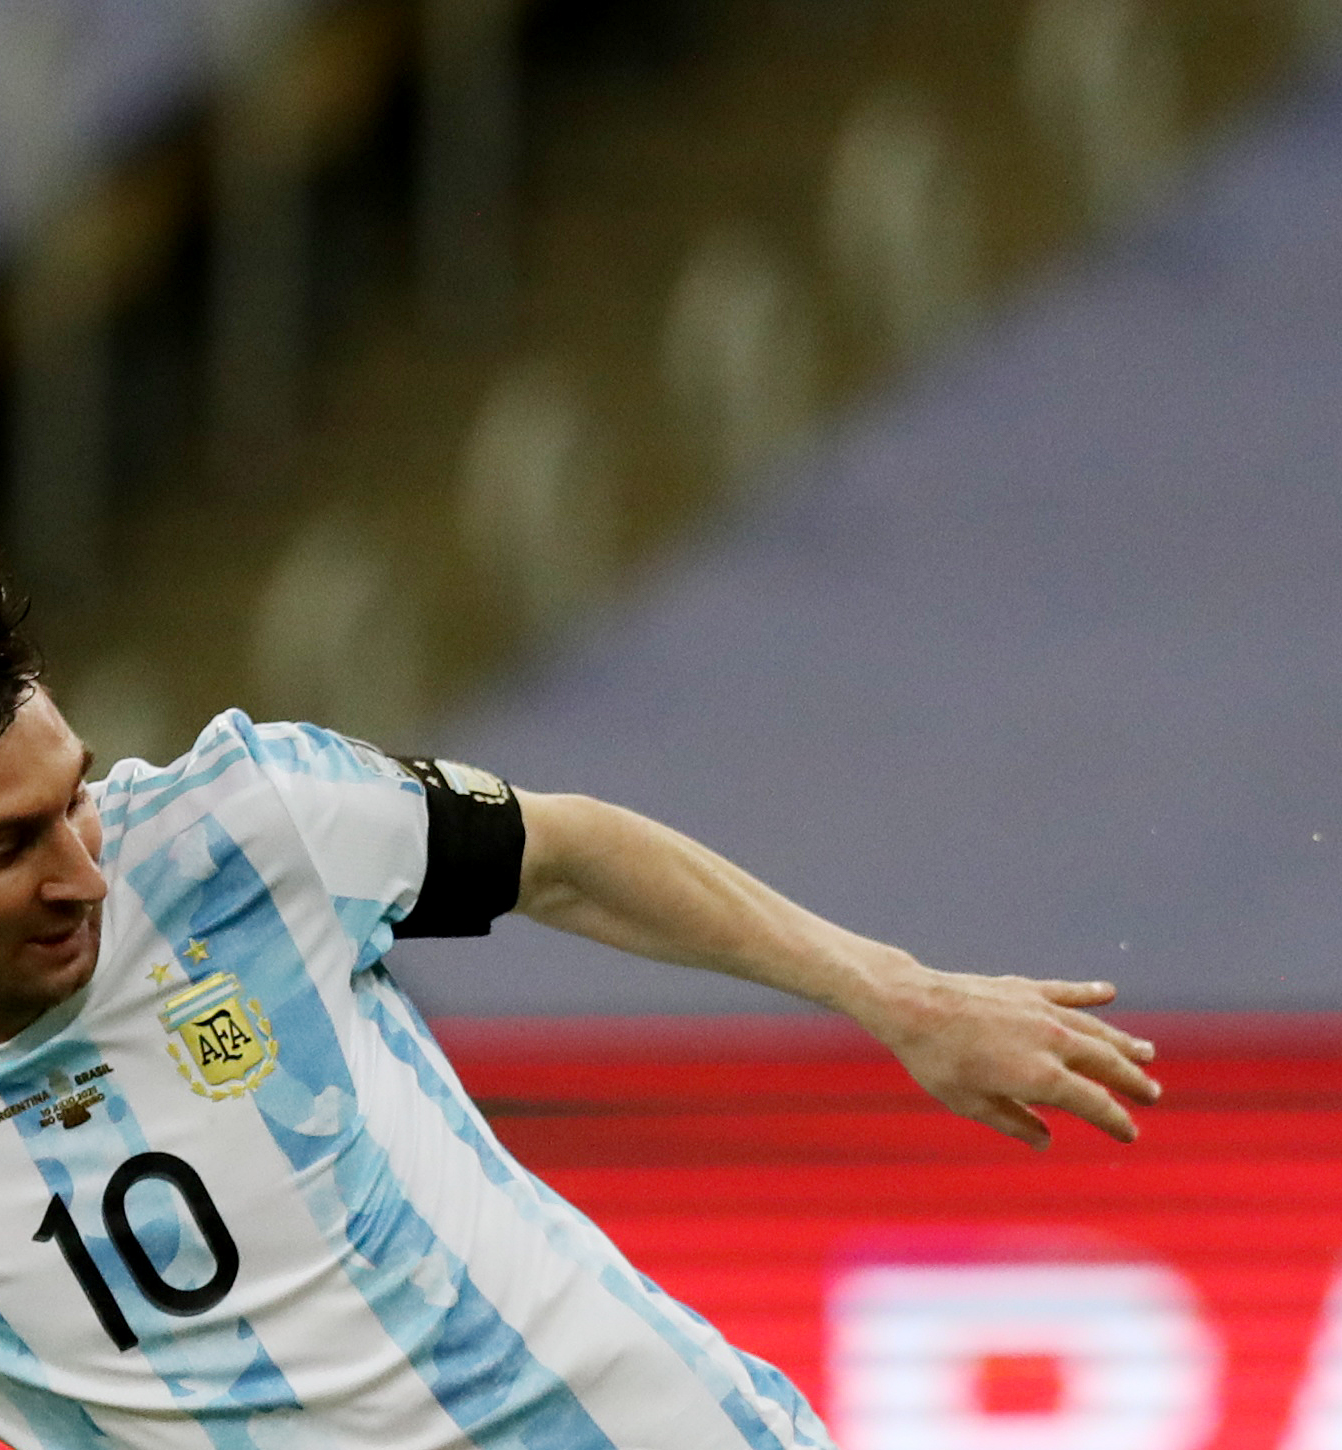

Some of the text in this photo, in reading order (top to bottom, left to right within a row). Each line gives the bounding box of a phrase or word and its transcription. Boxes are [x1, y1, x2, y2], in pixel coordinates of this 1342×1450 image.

[192, 1009, 251, 1066] AFA
[74, 1063, 114, 1085] BRASIL
[32, 1151, 240, 1353] 10
